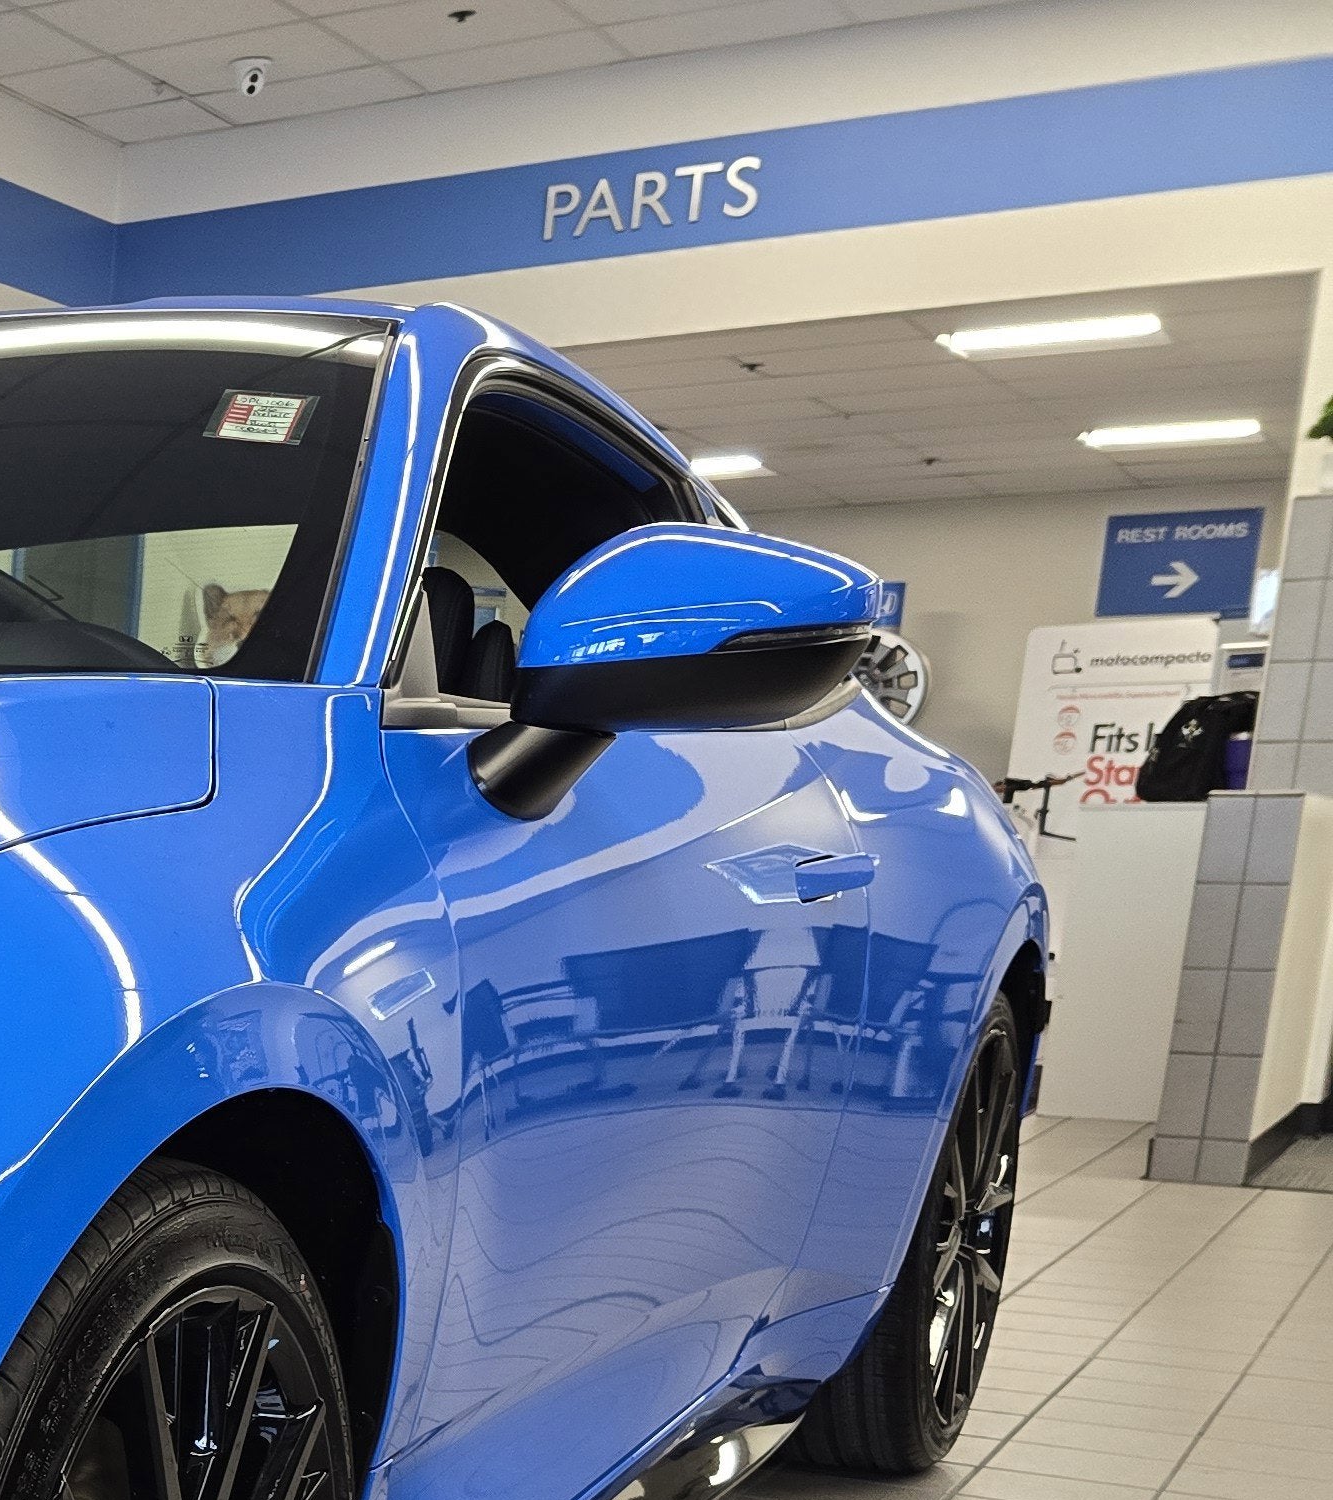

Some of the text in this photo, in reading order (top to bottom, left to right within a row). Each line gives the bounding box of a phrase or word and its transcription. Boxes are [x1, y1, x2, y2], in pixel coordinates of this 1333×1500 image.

[542, 155, 762, 241] PARTS
[1116, 521, 1249, 544] REST ROOMS
[1090, 651, 1212, 667] motocompacto
[1090, 722, 1139, 752] Fits
